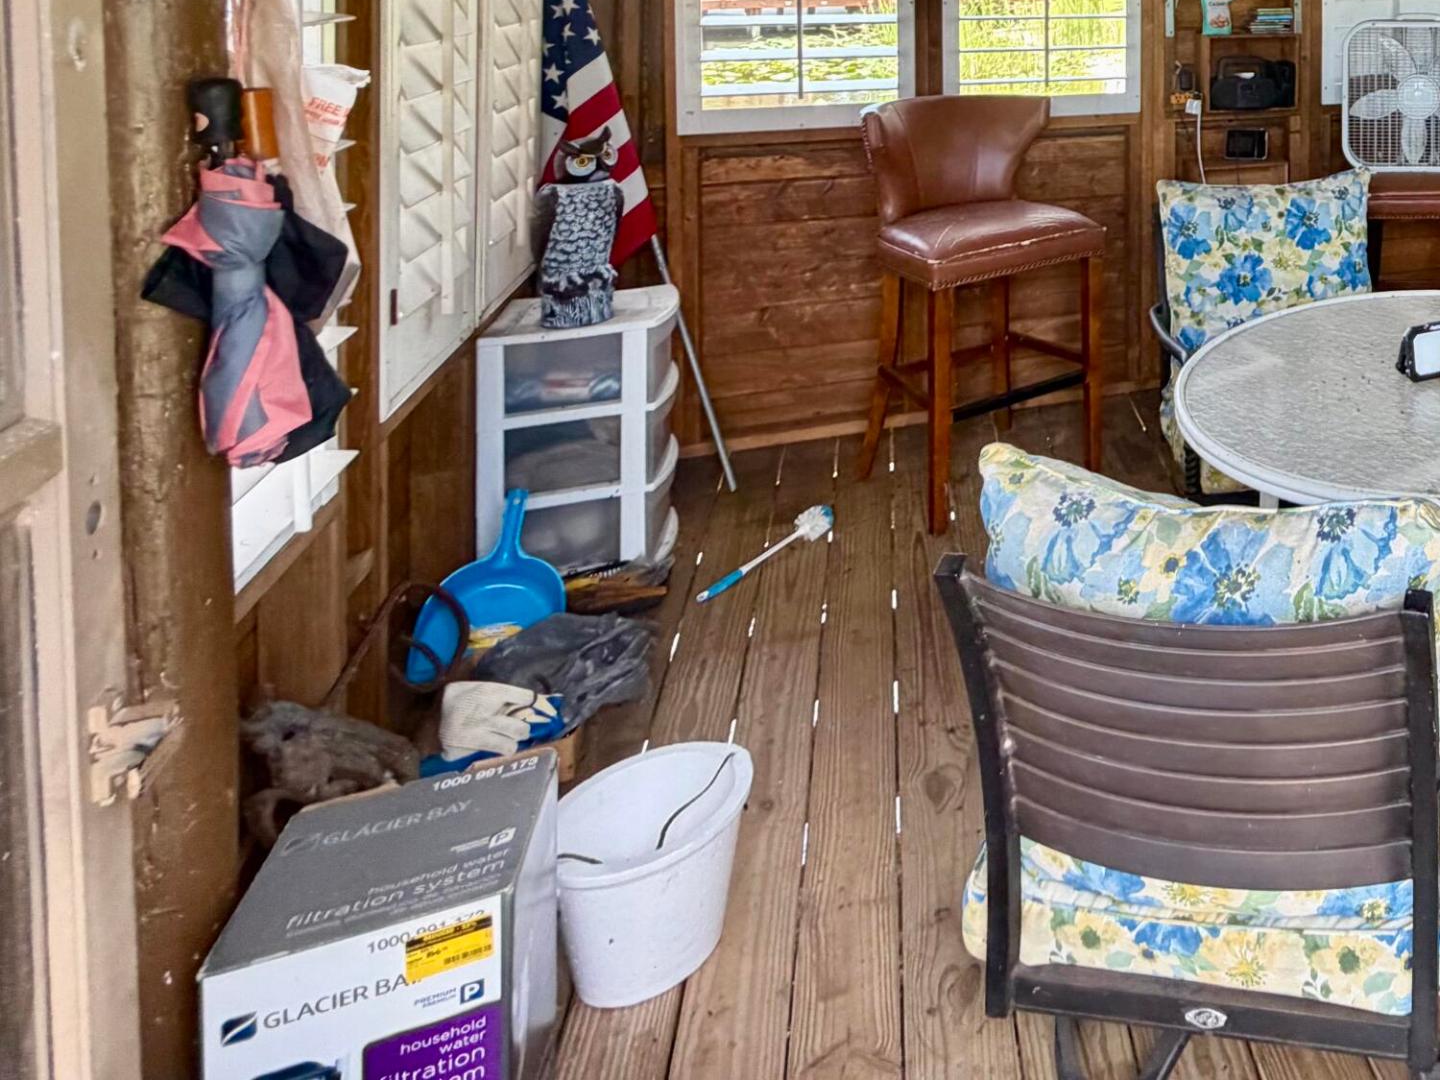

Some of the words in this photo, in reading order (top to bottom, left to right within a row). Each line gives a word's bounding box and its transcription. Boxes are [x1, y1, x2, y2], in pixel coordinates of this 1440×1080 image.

[308, 96, 343, 116] FREE
[432, 773, 472, 792] 1000
[322, 812, 422, 846] GLACIER
[426, 799, 472, 820] BAY
[462, 847, 510, 869] water
[286, 888, 404, 931] filtration
[413, 860, 505, 897] system
[367, 930, 411, 954] 1000
[263, 984, 369, 1030] GLACIER
[375, 973, 413, 997] BA
[400, 1015, 487, 1056] household
[439, 1029, 487, 1055] water
[380, 1046, 486, 1080] tration
